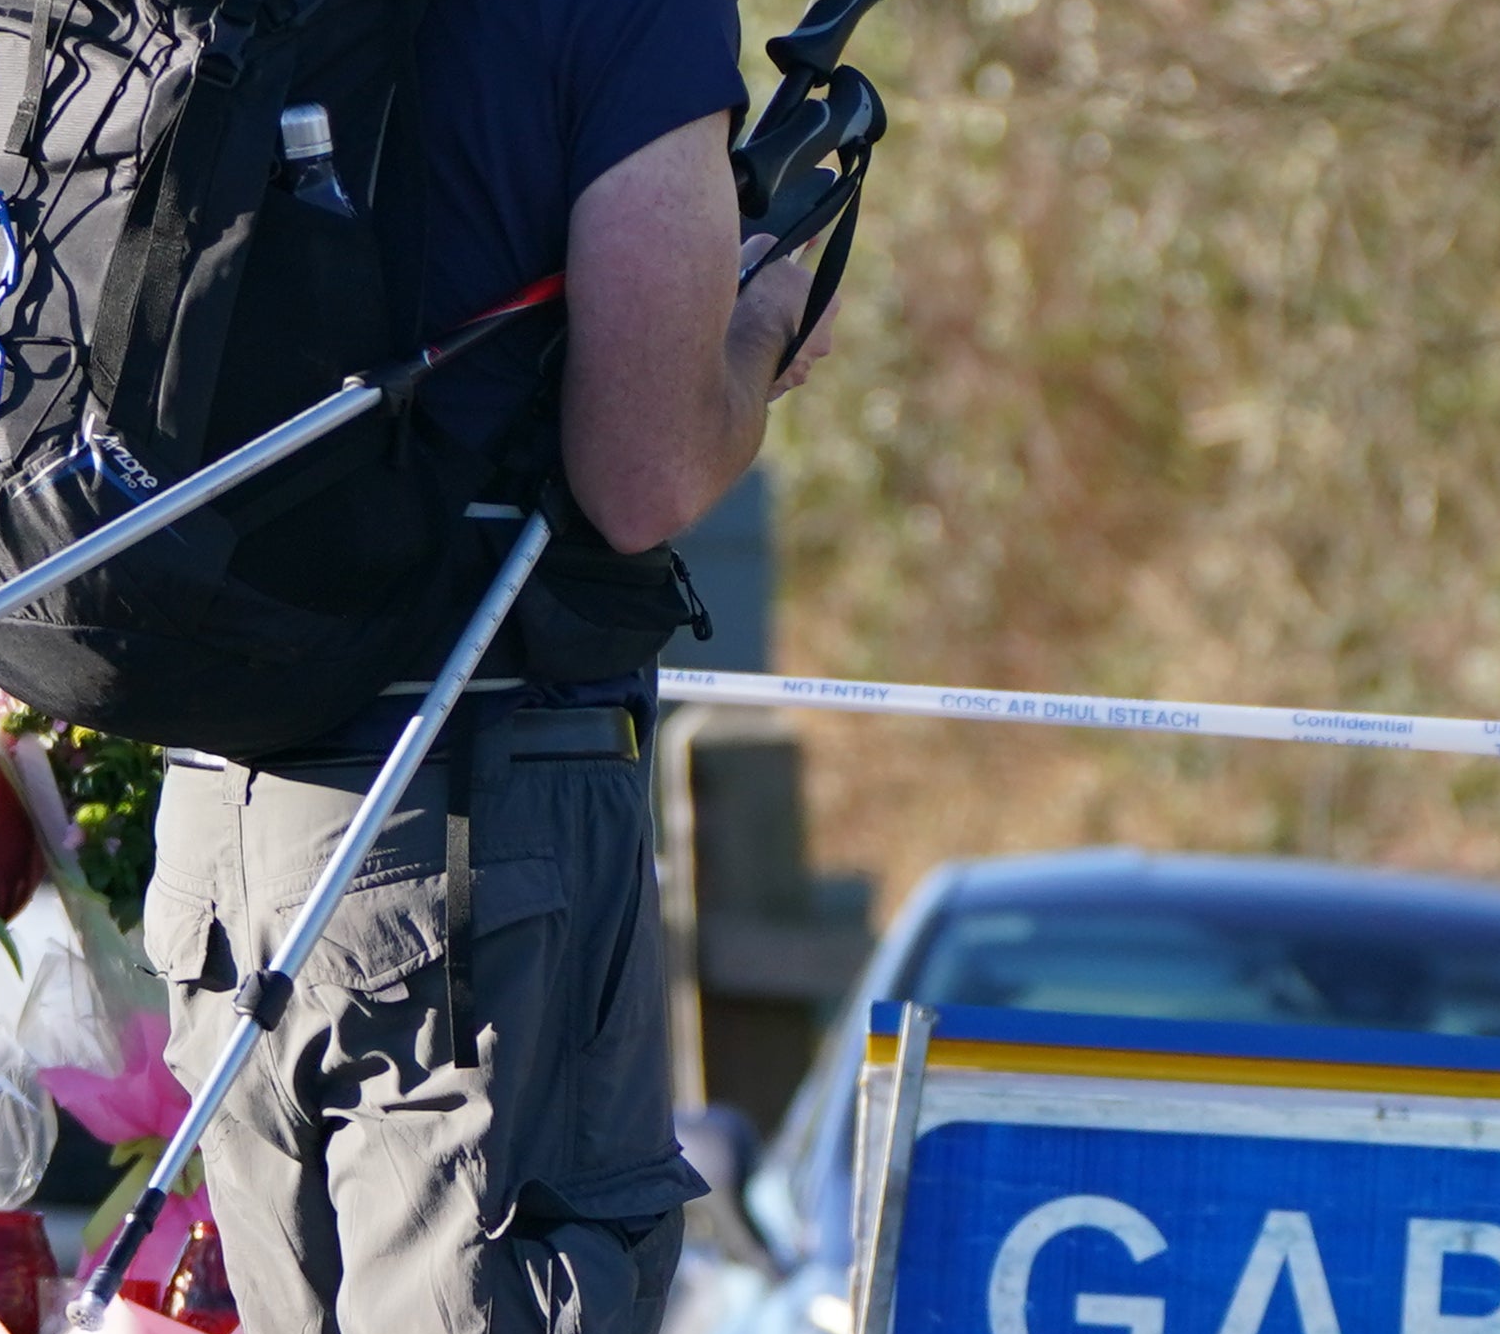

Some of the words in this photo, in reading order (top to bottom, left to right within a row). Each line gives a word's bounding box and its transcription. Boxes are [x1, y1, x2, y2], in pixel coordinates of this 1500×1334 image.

[941, 693, 1002, 713] COSC
[1007, 699, 1036, 713] AR
[1044, 702, 1099, 721] DHUL
[1108, 707, 1200, 728] ISTEACH
[1293, 712, 1413, 734] Confidential
